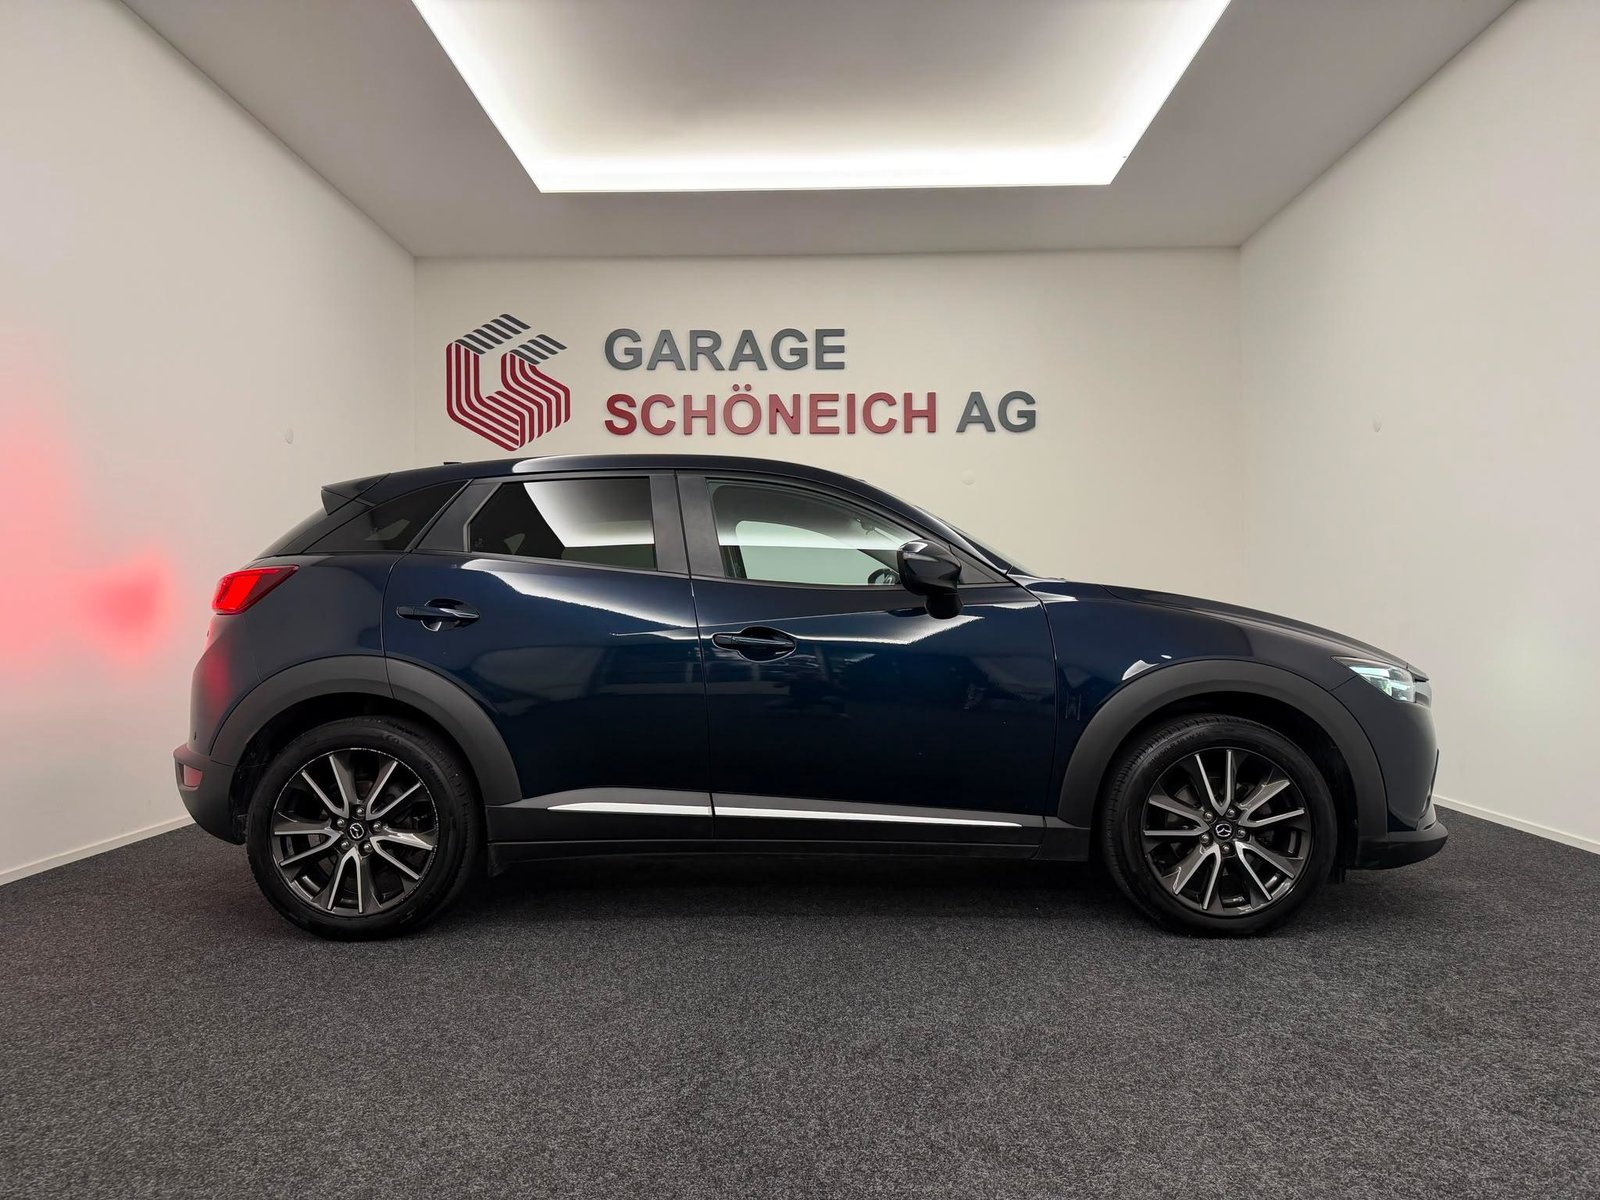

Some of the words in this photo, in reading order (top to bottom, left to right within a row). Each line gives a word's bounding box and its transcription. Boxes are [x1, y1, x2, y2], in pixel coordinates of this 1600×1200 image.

[605, 328, 845, 371] GARAGE
[605, 384, 936, 436] SCHÖNEICH
[956, 391, 1036, 433] AG
